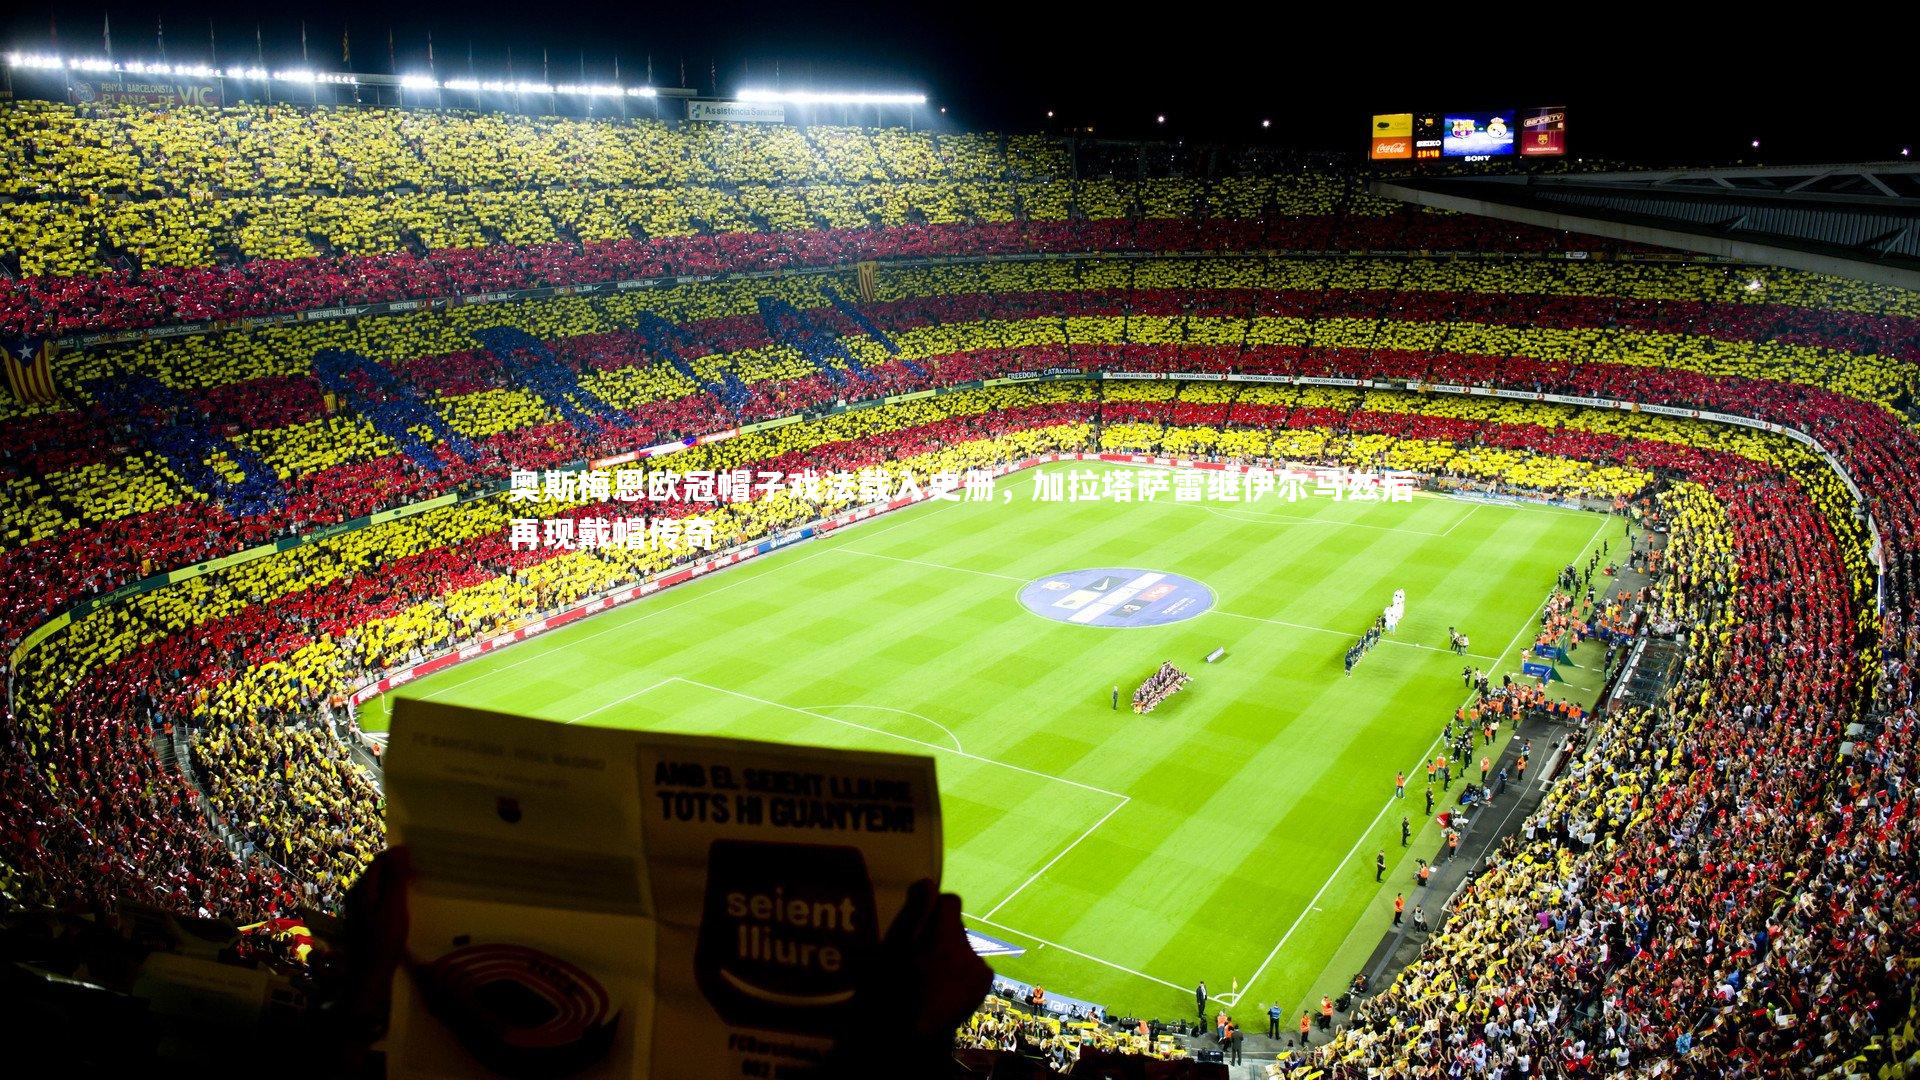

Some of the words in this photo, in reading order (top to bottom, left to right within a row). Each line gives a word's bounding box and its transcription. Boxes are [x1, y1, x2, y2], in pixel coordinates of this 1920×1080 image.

[177, 84, 214, 106] VIC
[657, 791, 731, 824] TOTS
[736, 794, 763, 825] HI
[726, 885, 857, 932] seient
[738, 923, 843, 972] lliure
